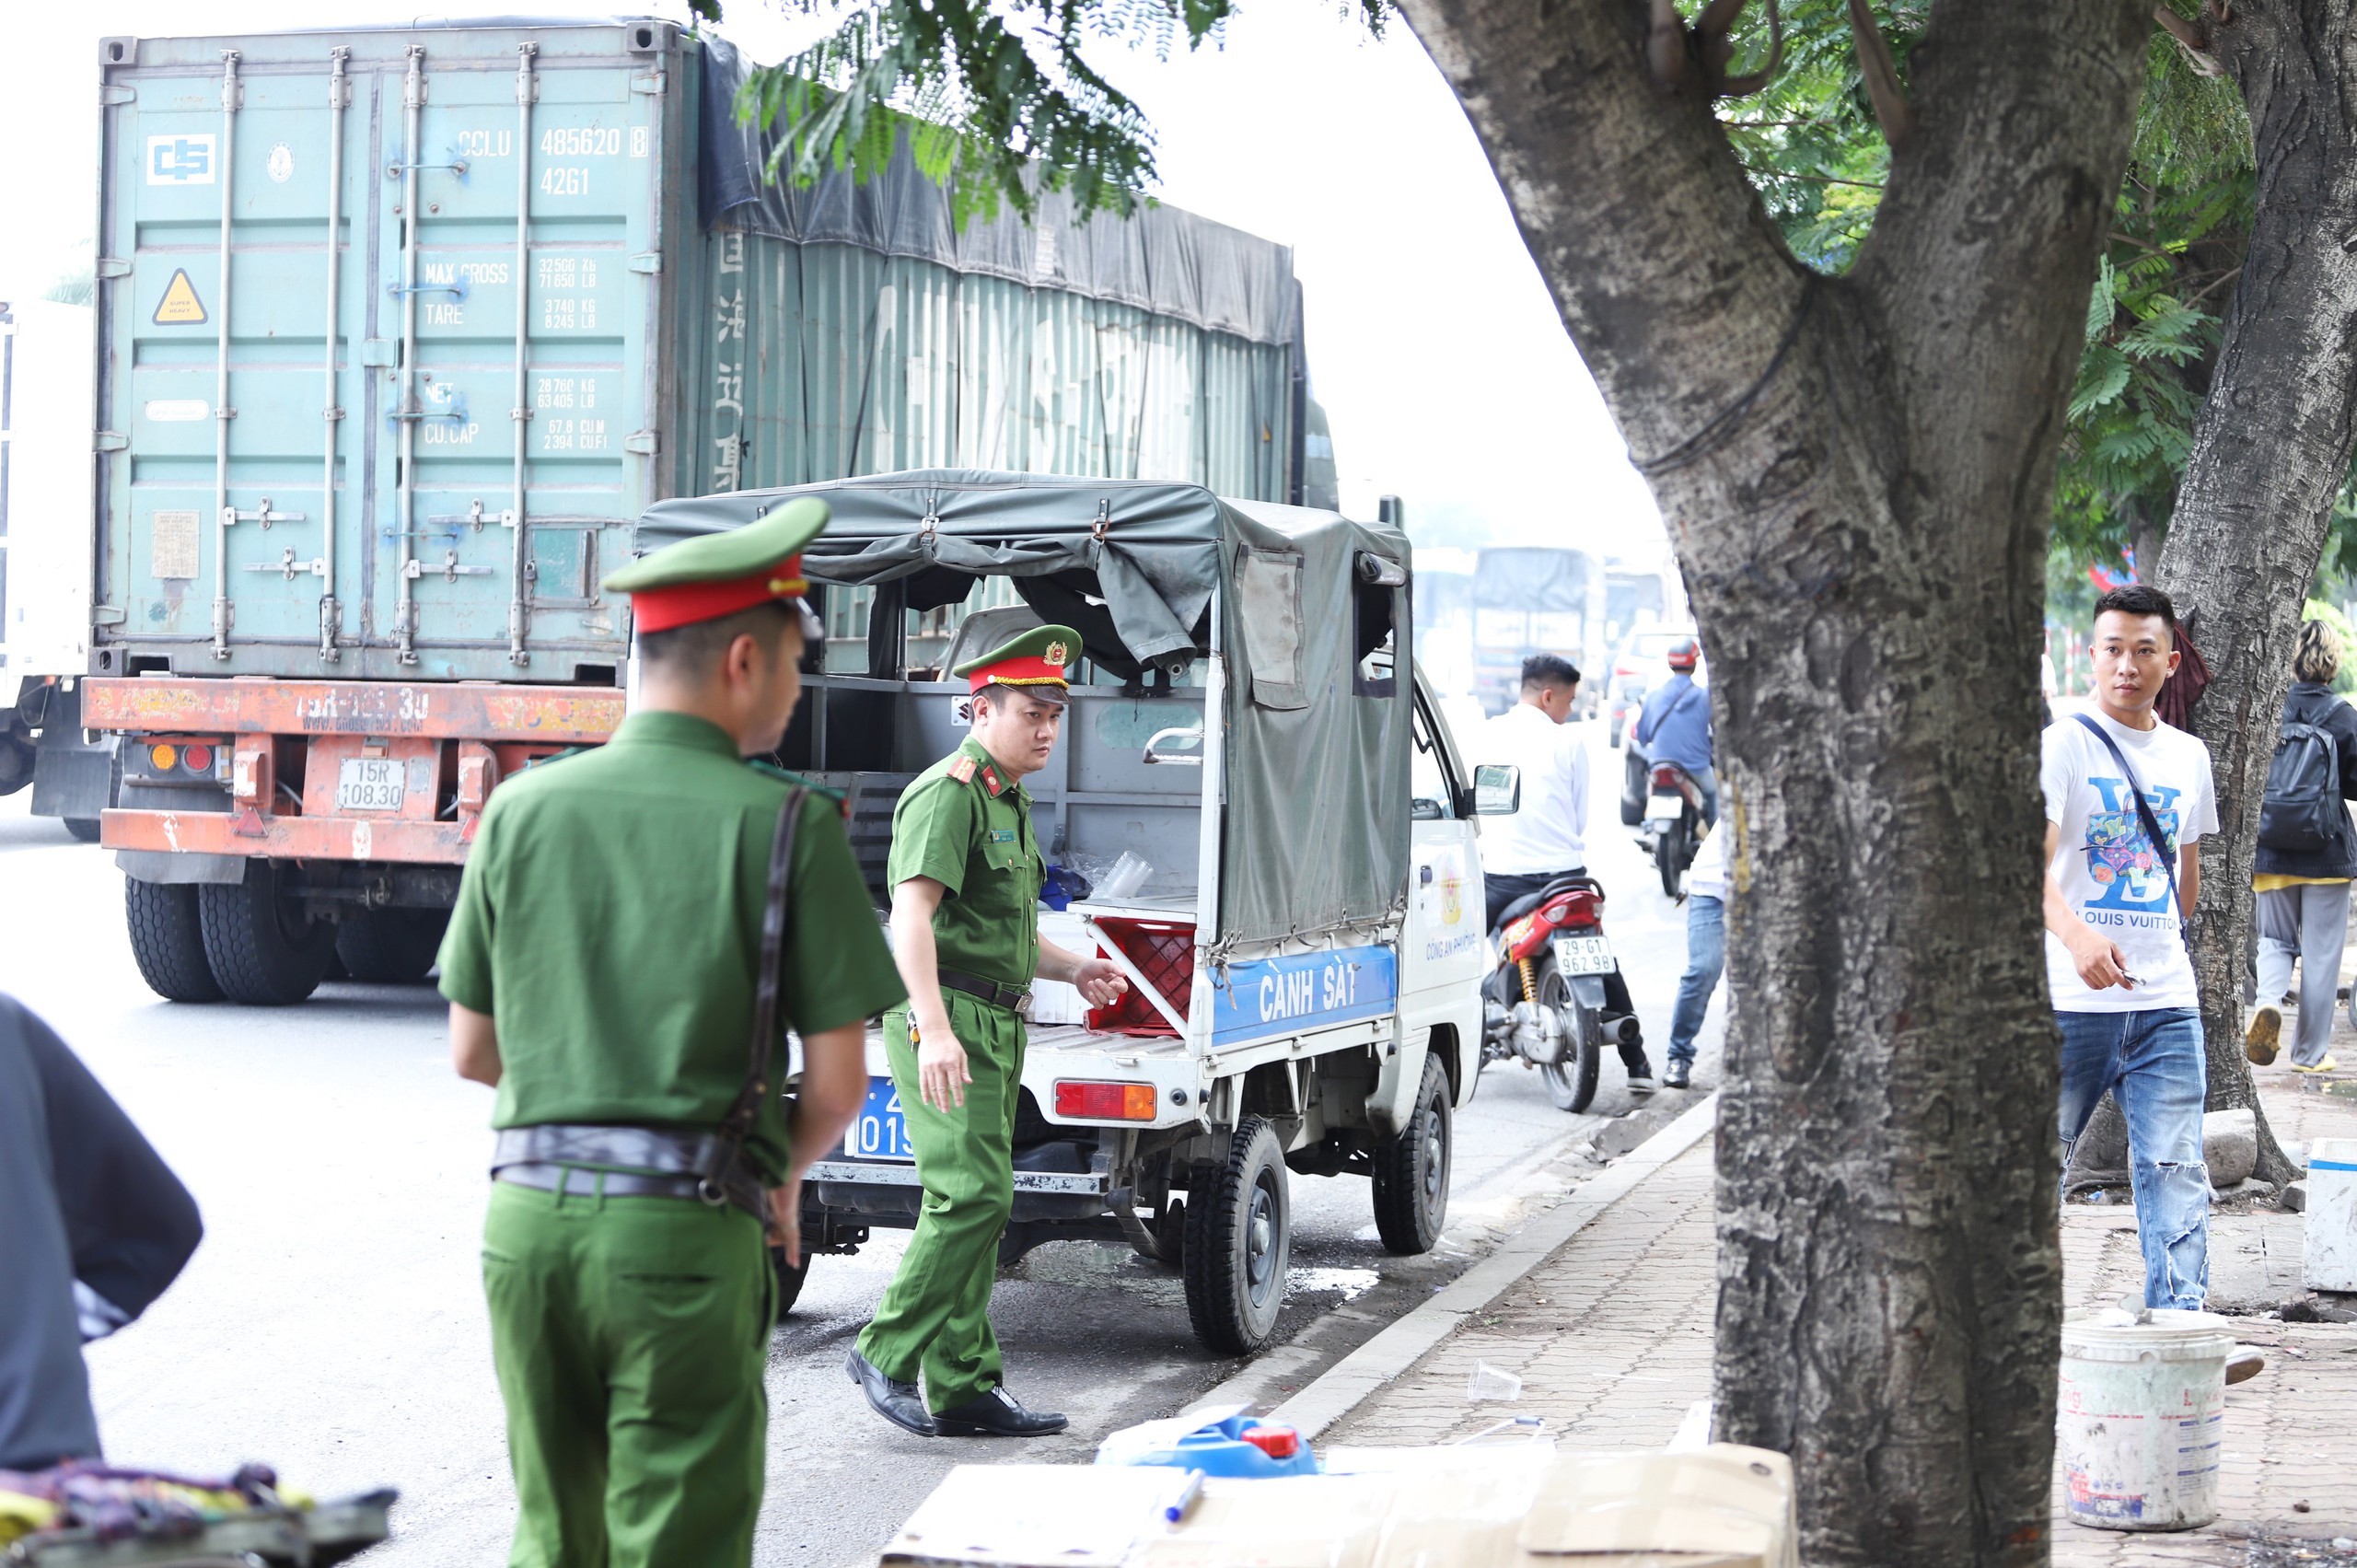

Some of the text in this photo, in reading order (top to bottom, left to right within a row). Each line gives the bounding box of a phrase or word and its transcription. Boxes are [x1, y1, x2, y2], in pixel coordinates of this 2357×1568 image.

[459, 130, 511, 157] CCLU
[540, 128, 620, 155] 485620
[540, 168, 589, 194] 42G1
[461, 263, 508, 284] GROSS
[425, 304, 463, 325] TARE
[582, 299, 596, 313] KG
[581, 315, 596, 329] LB
[425, 382, 454, 403] NET
[581, 378, 596, 393] KG
[580, 394, 595, 408] LB
[358, 761, 390, 784] 15R
[343, 784, 401, 806] 108.30
[2076, 911, 2124, 926] OUIS
[1563, 939, 1603, 956] 29-G1
[1562, 956, 1610, 973] 962.98
